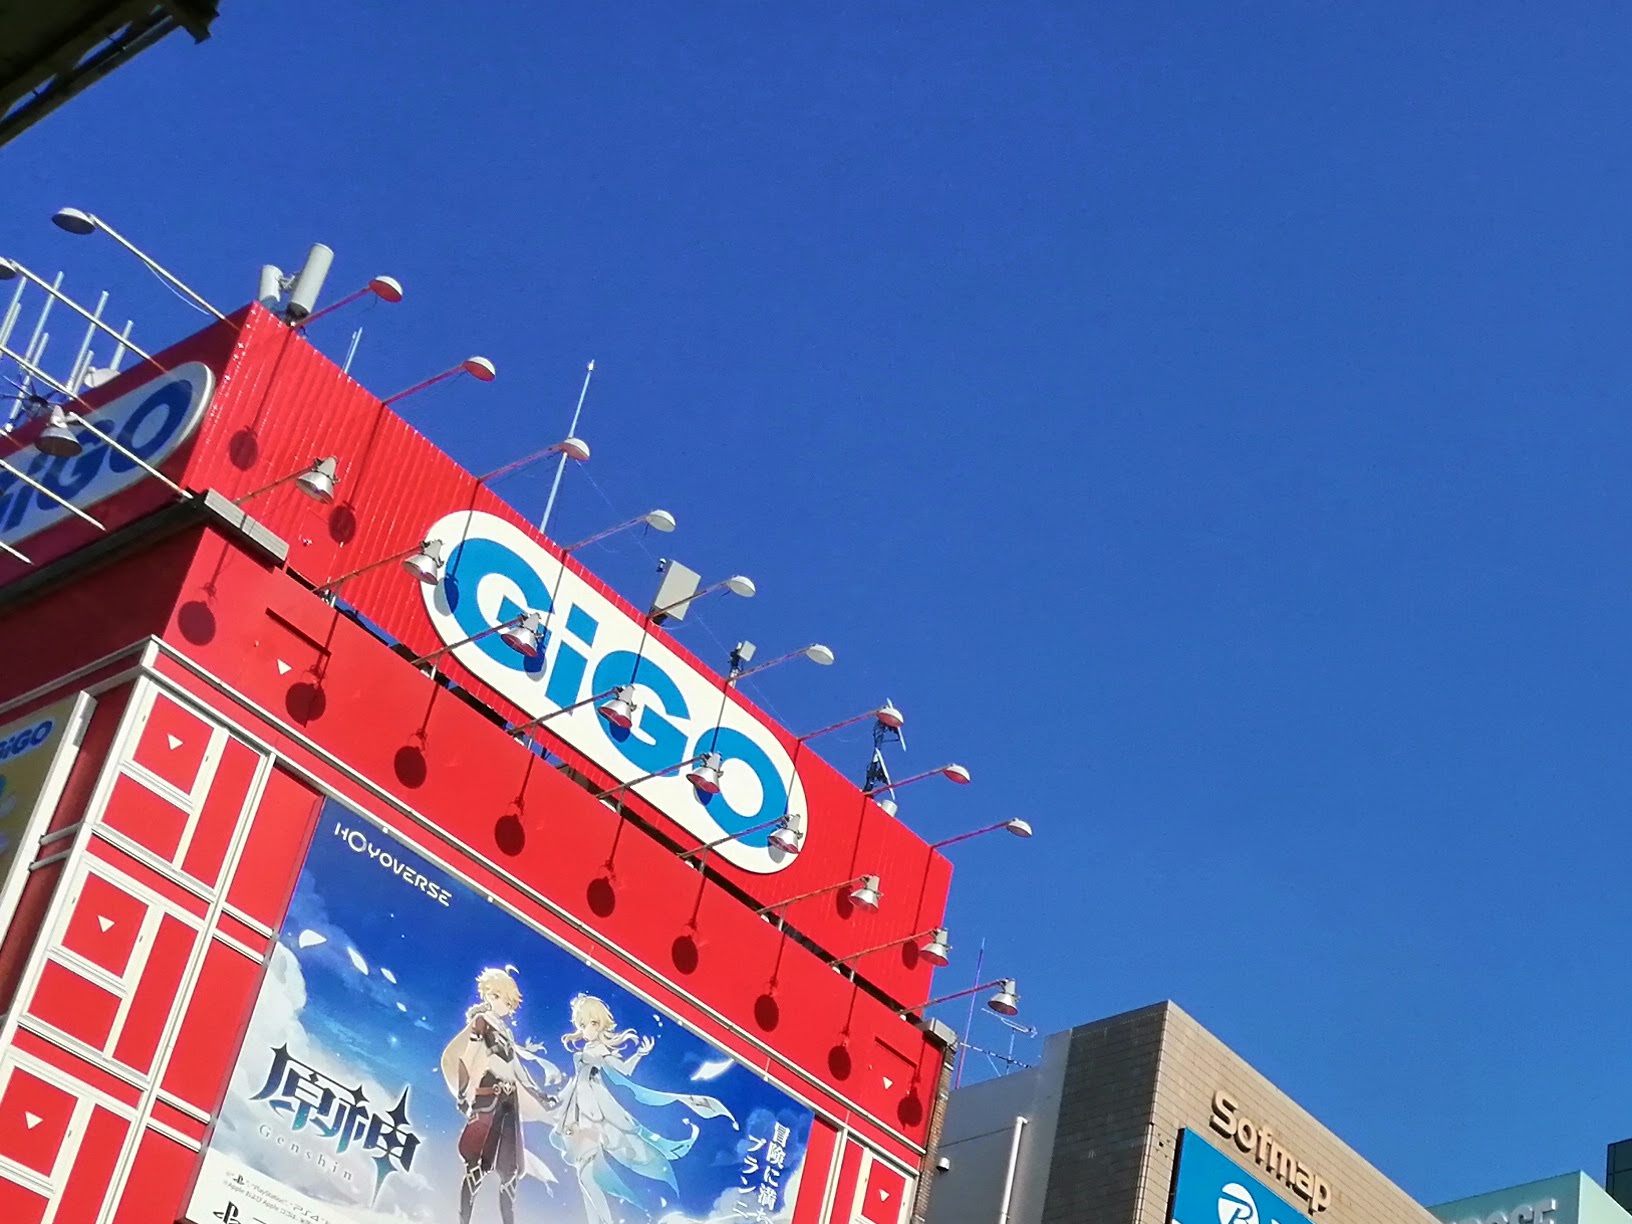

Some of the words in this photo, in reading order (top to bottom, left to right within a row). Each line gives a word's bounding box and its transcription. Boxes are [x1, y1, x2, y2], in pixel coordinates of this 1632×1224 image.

[446, 536, 791, 849] GiGO
[334, 822, 452, 906] HOYOVERSE
[258, 1123, 353, 1182] Genshin
[1210, 1090, 1332, 1216] Sofmap
